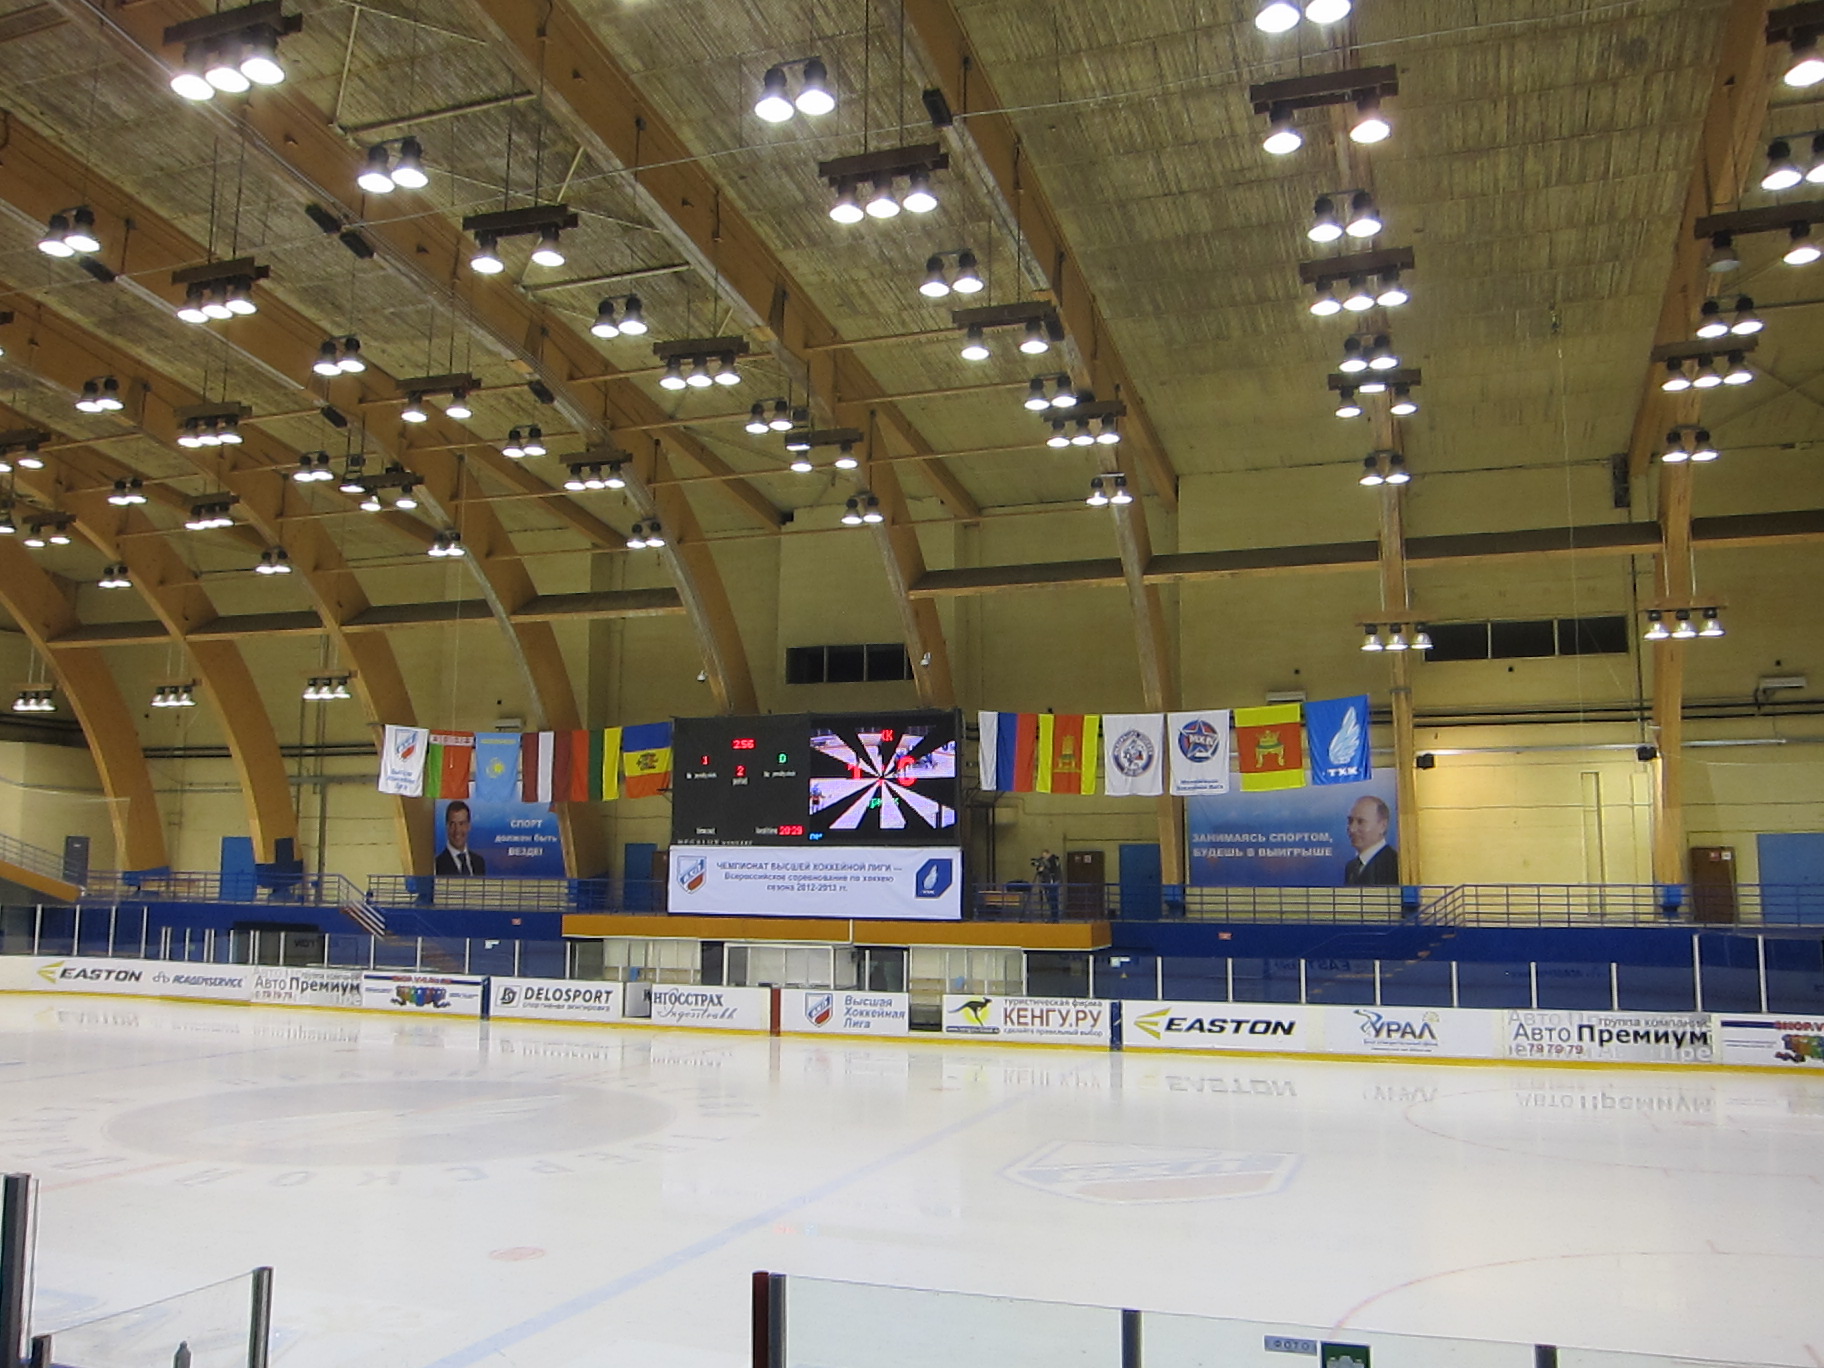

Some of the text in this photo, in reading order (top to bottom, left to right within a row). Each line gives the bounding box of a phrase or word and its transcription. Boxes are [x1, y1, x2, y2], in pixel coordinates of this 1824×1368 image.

[736, 765, 745, 776] 2
[1327, 767, 1359, 777] ТХК
[510, 819, 543, 830] СПОРТ
[1192, 832, 1333, 844] ЗАНИМАЯСЬ СПОРТОМ,
[1193, 847, 1243, 858] БУДЕШЬ
[1258, 847, 1333, 857] ВЫИГРЫШЕ
[716, 862, 768, 871] ЧЕМПИОНАТ
[770, 861, 811, 872] ВЫСШЕЙ
[812, 862, 867, 872] ХОККЕЙНОЙ
[59, 967, 144, 983] EASTON
[254, 975, 287, 990] Авто
[289, 976, 361, 996] Премиум
[524, 986, 614, 1005] DELOSPORT
[844, 994, 893, 1008] Высшая
[843, 1006, 906, 1020] Хоккейная
[1003, 1007, 1102, 1028] КЕНГУ.РУ
[843, 1018, 871, 1029] Лига
[1164, 1017, 1296, 1036] EASTON
[1512, 1022, 1709, 1049] Авто Премиум
